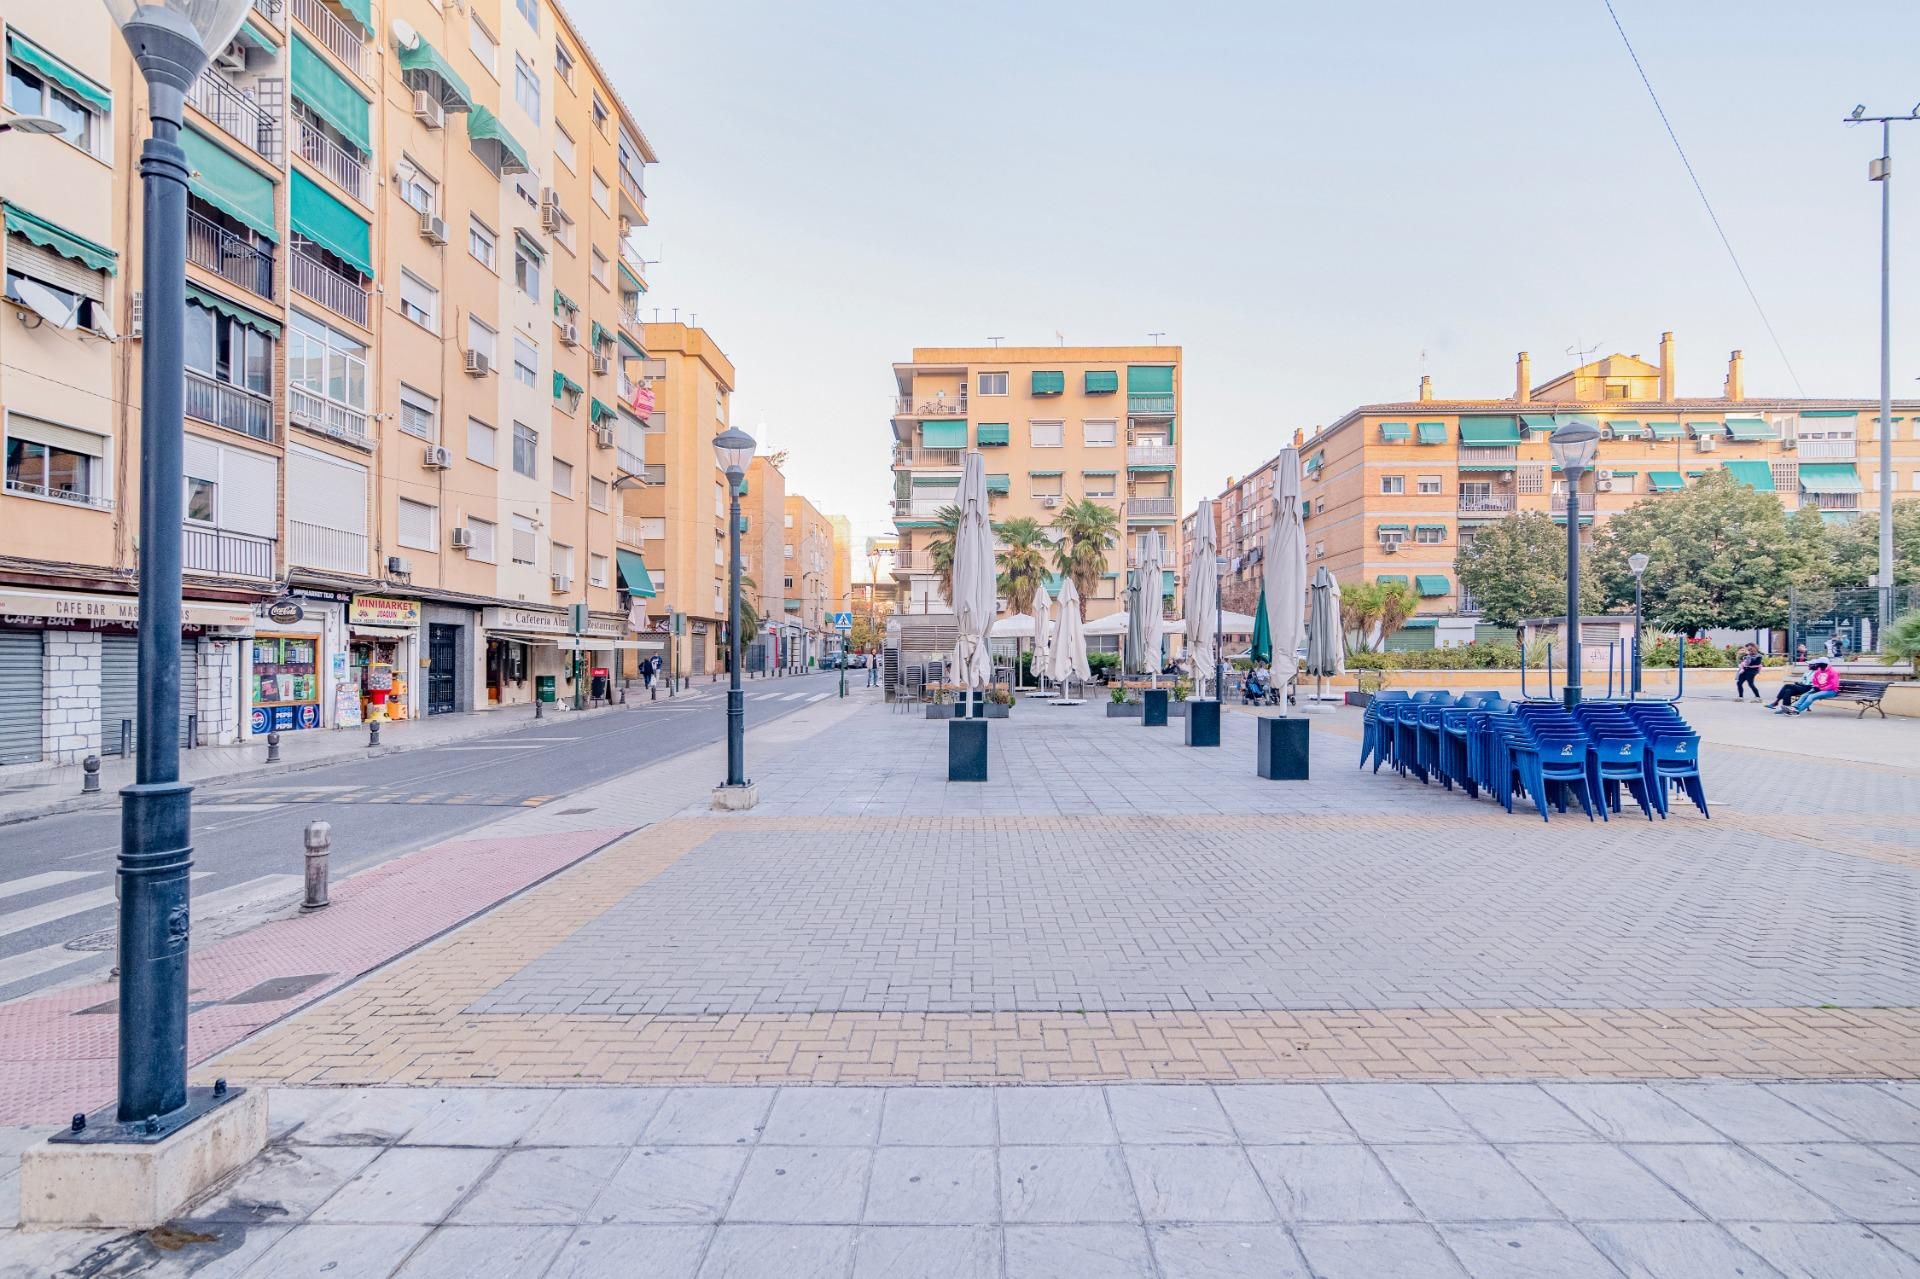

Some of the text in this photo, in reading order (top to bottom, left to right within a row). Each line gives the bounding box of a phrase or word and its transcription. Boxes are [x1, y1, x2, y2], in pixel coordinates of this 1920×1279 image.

[56, 601, 82, 614] CAFE
[87, 603, 105, 616] BAR
[357, 599, 413, 611] MINIMARKET
[4, 613, 42, 625] CAFE
[47, 616, 76, 627] BAR
